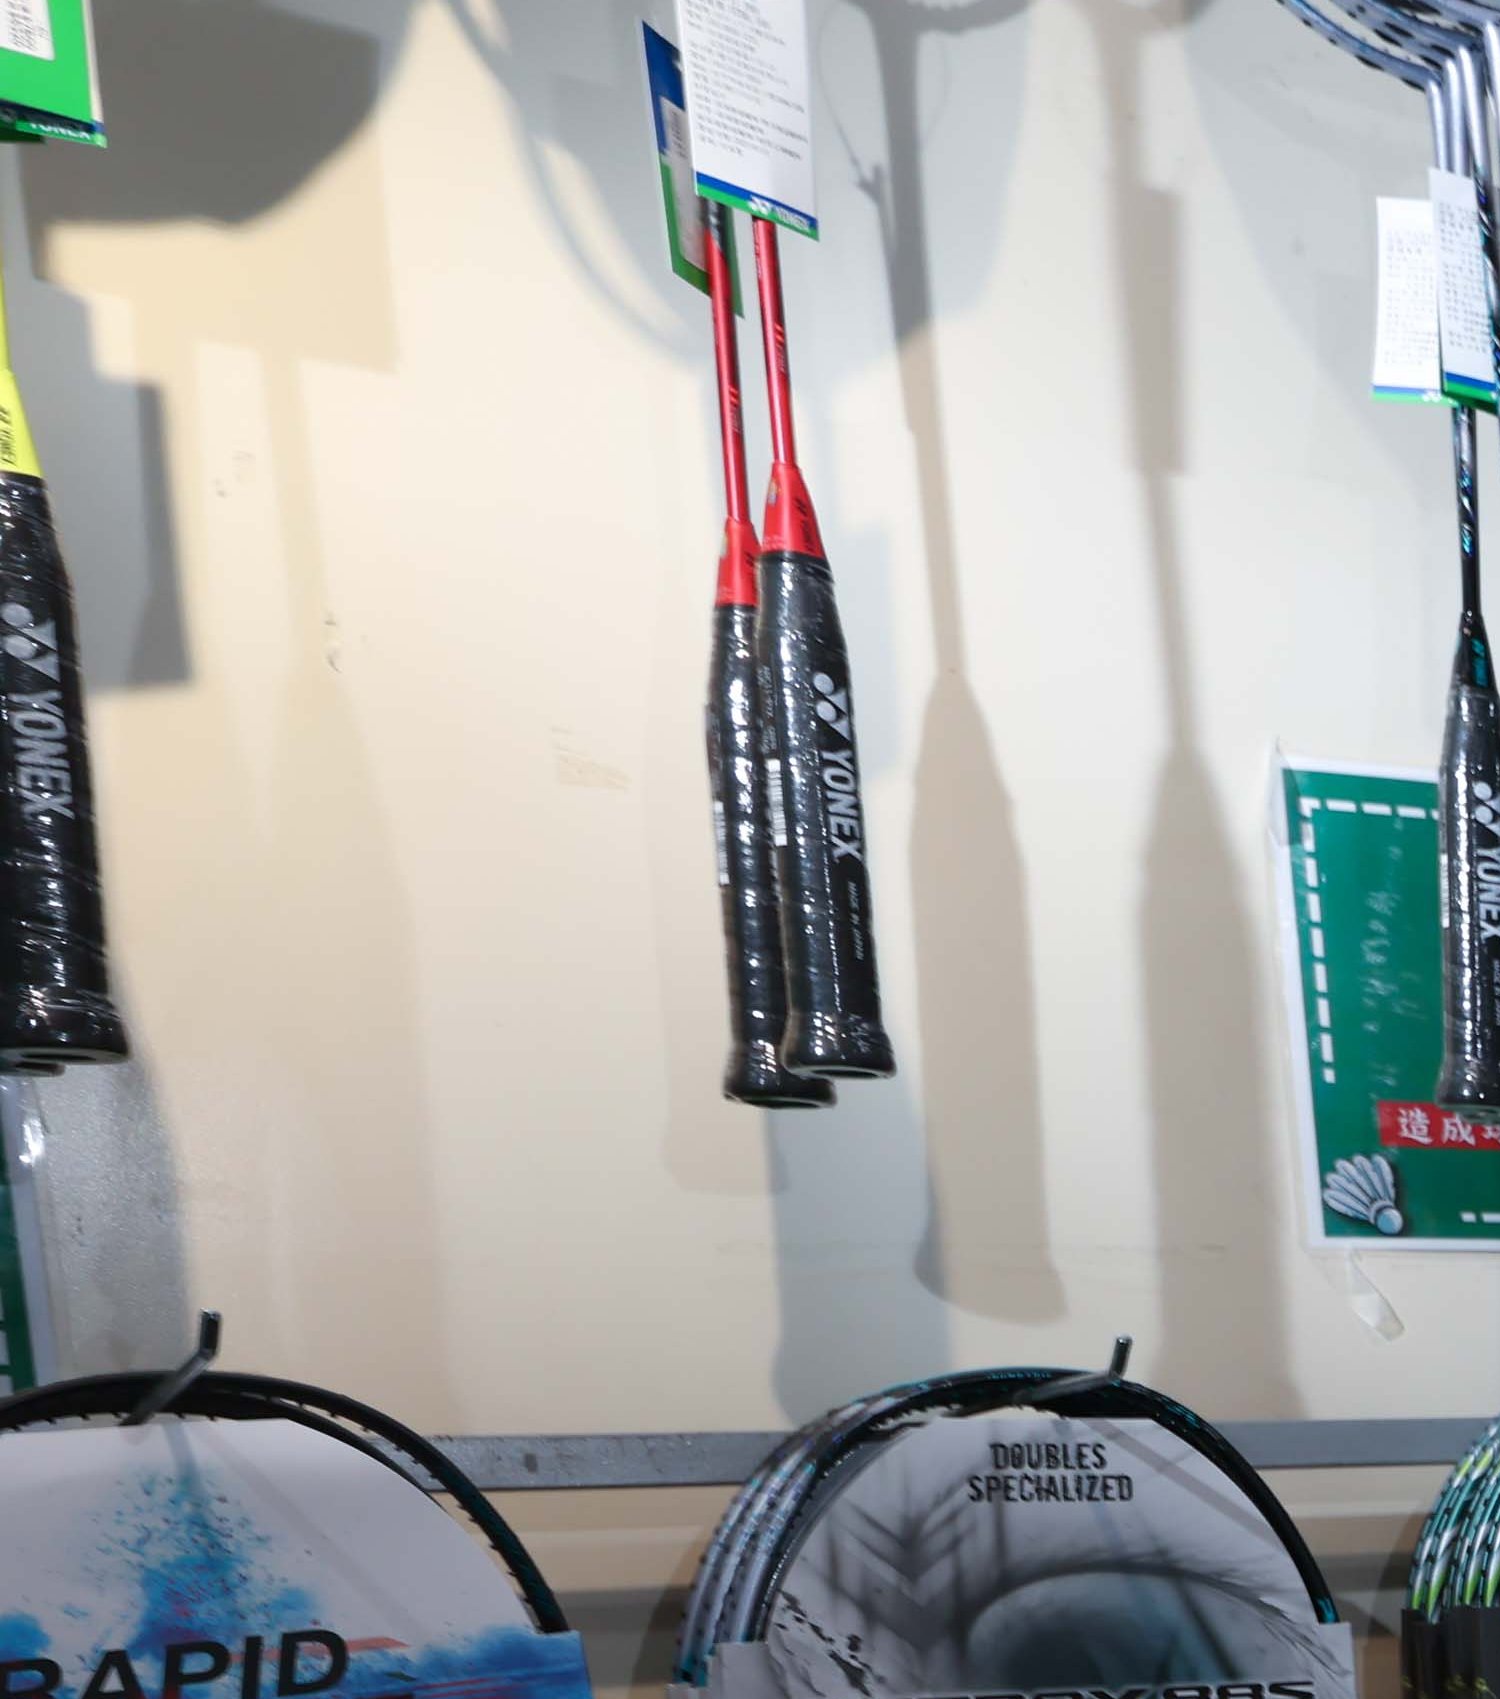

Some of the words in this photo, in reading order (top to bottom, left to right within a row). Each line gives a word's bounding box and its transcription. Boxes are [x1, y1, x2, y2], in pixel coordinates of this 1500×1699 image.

[8, 689, 75, 821] YONEX
[819, 750, 862, 864] YONEX
[967, 1473, 1134, 1504] SPECIALIZED
[989, 1441, 1106, 1472] DOUBLES
